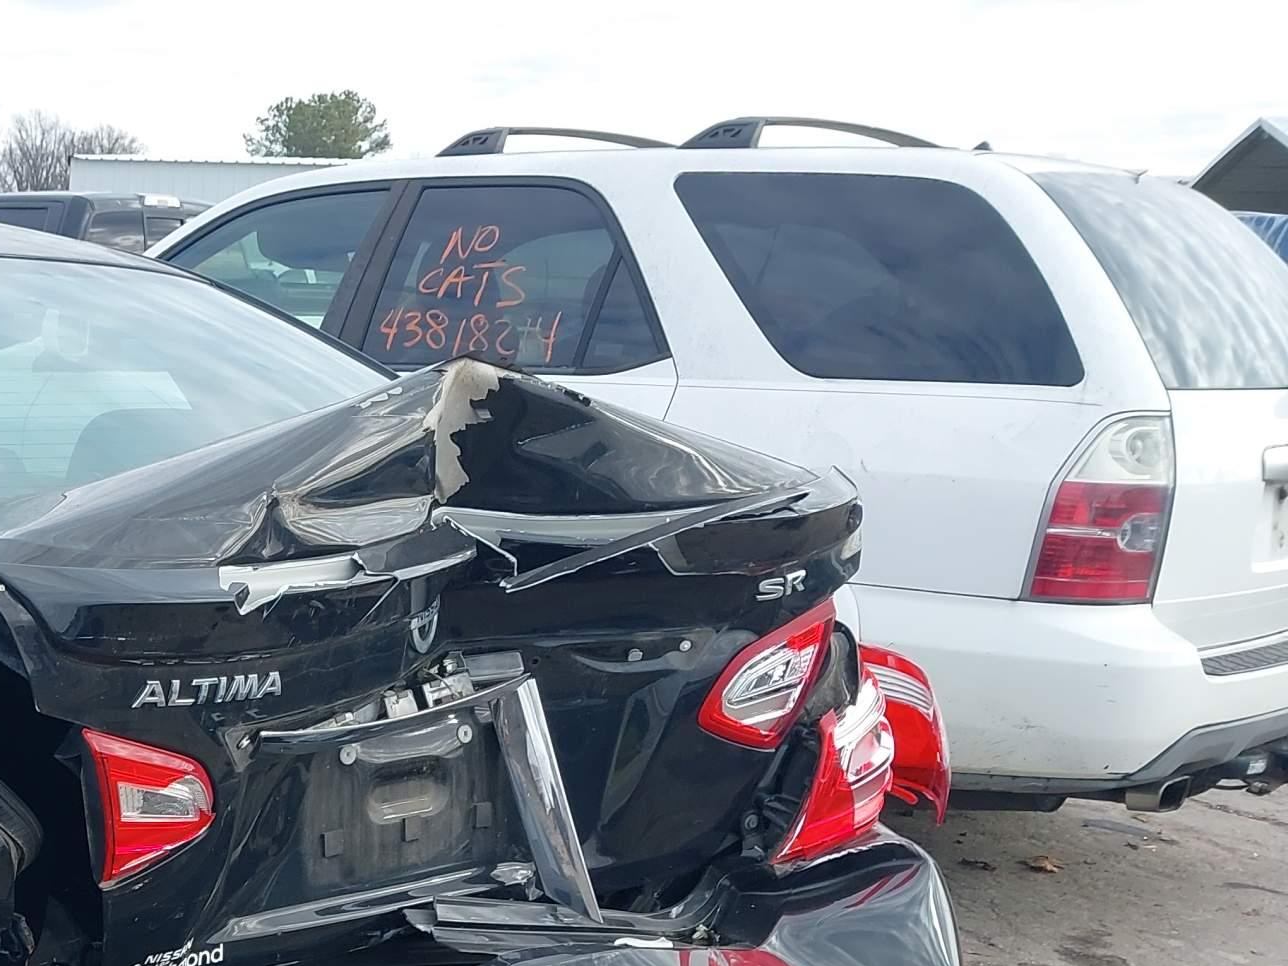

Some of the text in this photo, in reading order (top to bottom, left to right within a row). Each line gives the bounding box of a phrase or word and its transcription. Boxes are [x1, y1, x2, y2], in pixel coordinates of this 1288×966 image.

[439, 225, 500, 264] NO
[418, 259, 527, 308] CATS
[755, 569, 807, 601] SR
[130, 670, 284, 709] ALTIMA
[144, 937, 194, 965] NISSAN
